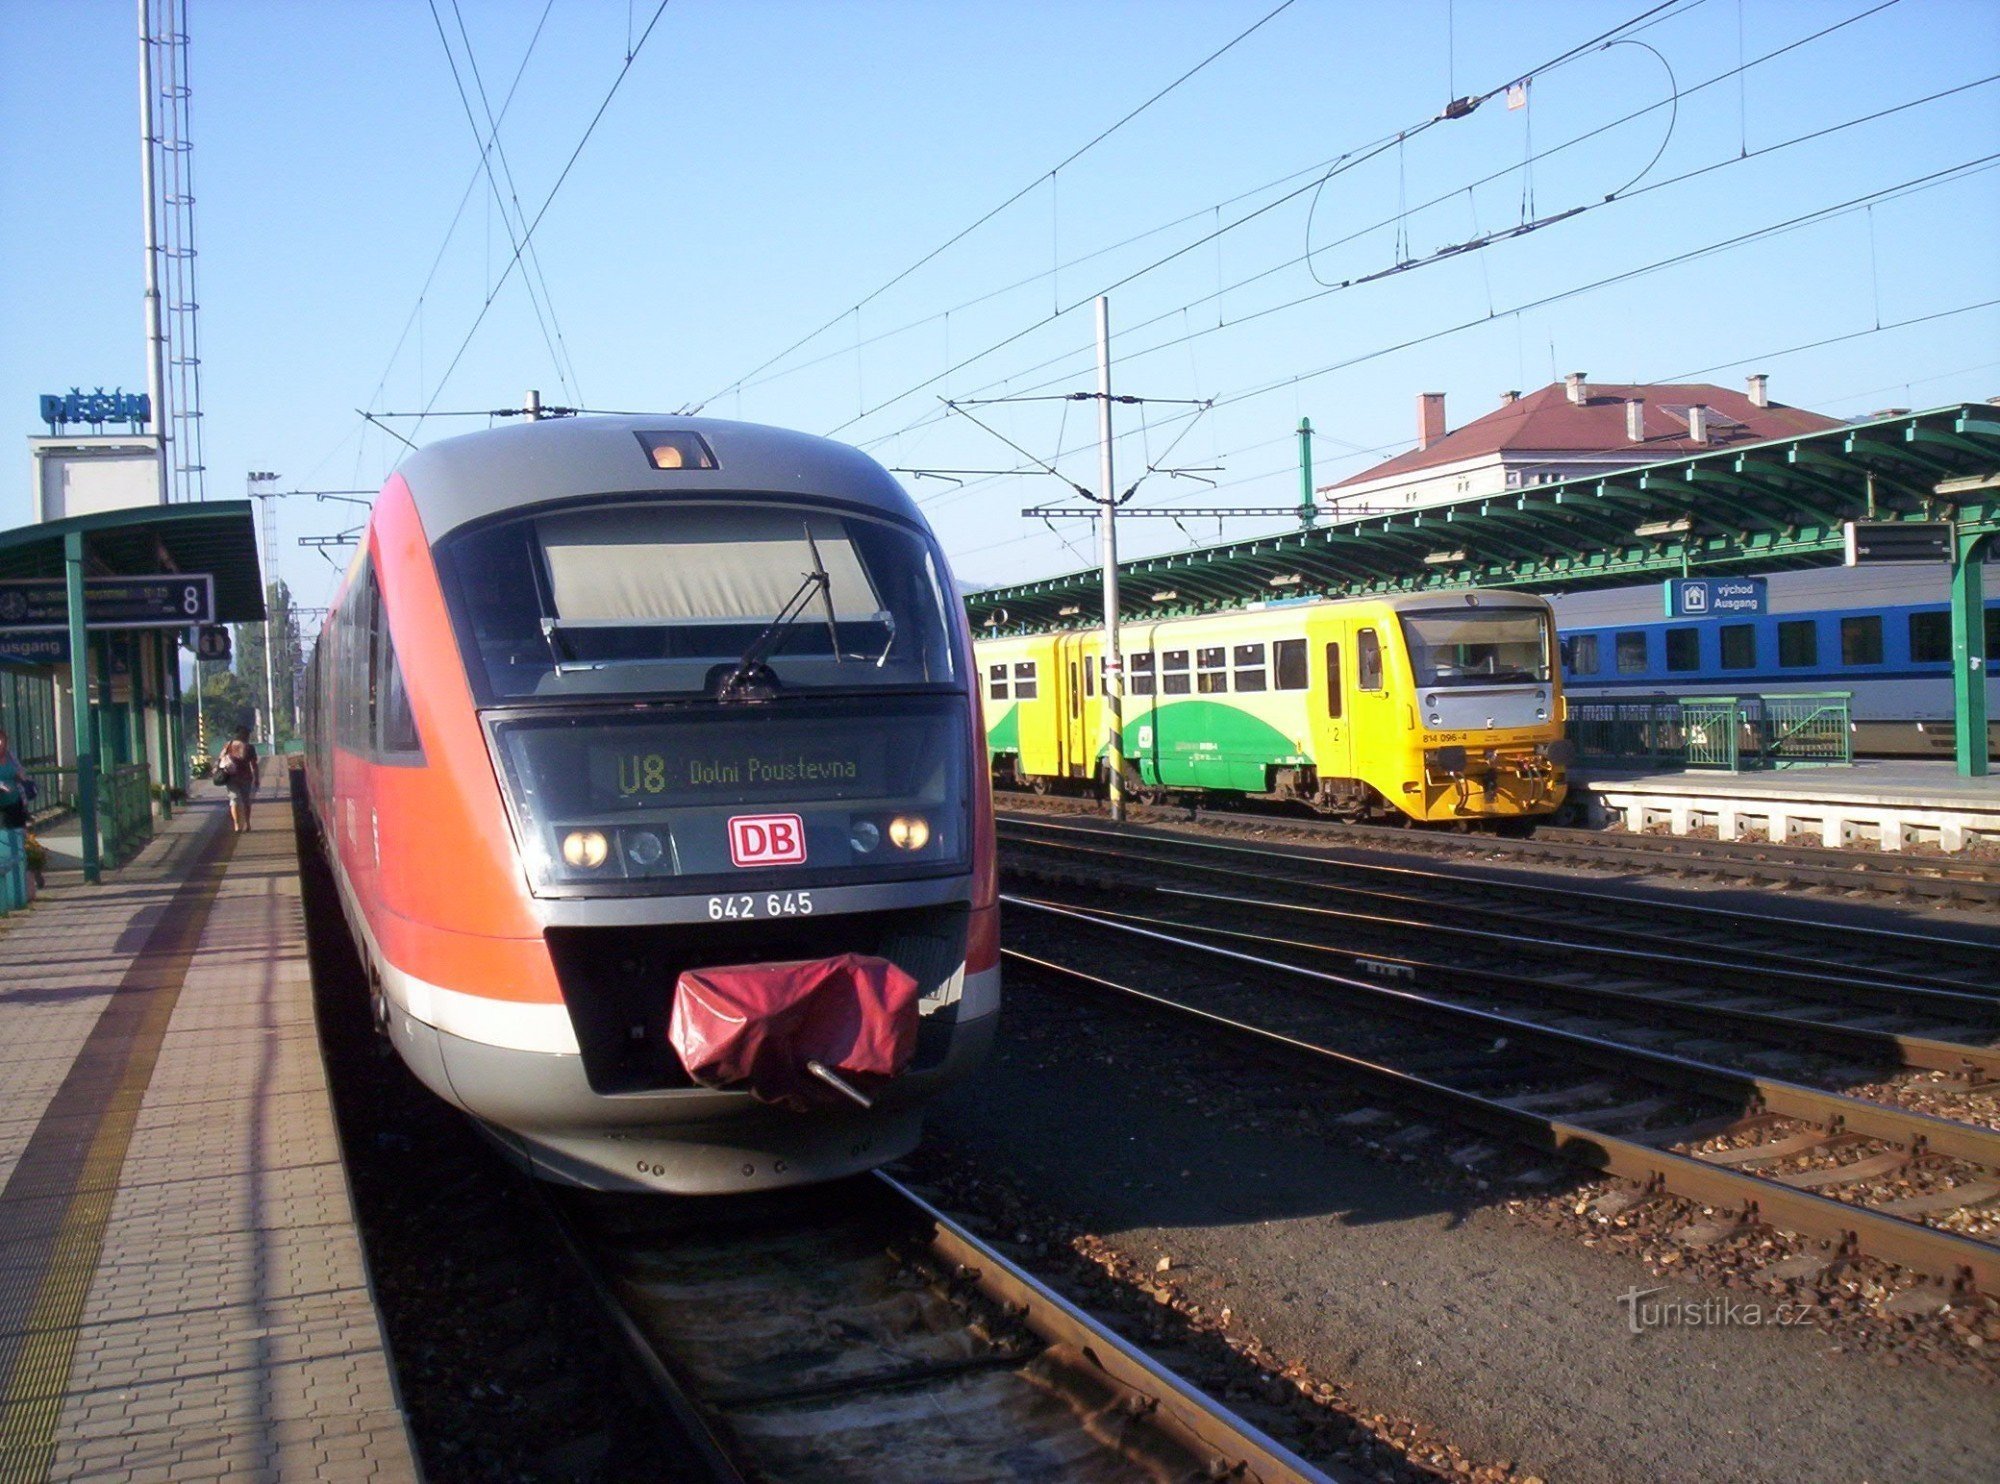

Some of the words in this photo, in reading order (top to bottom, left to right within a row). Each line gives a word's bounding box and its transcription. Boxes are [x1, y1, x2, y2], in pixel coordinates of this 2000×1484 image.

[183, 586, 199, 614] 8
[1717, 583, 1754, 597] východ
[1713, 597, 1758, 611] Ausgang
[0, 641, 61, 656] usgang
[1422, 735, 1438, 743] 814
[1440, 733, 1467, 743] 096-4
[619, 754, 666, 794] U8
[689, 760, 740, 785] Dolni
[748, 755, 857, 783] Poustevna
[739, 823, 796, 856] DB
[708, 896, 755, 920] 642
[767, 892, 812, 915] 645
